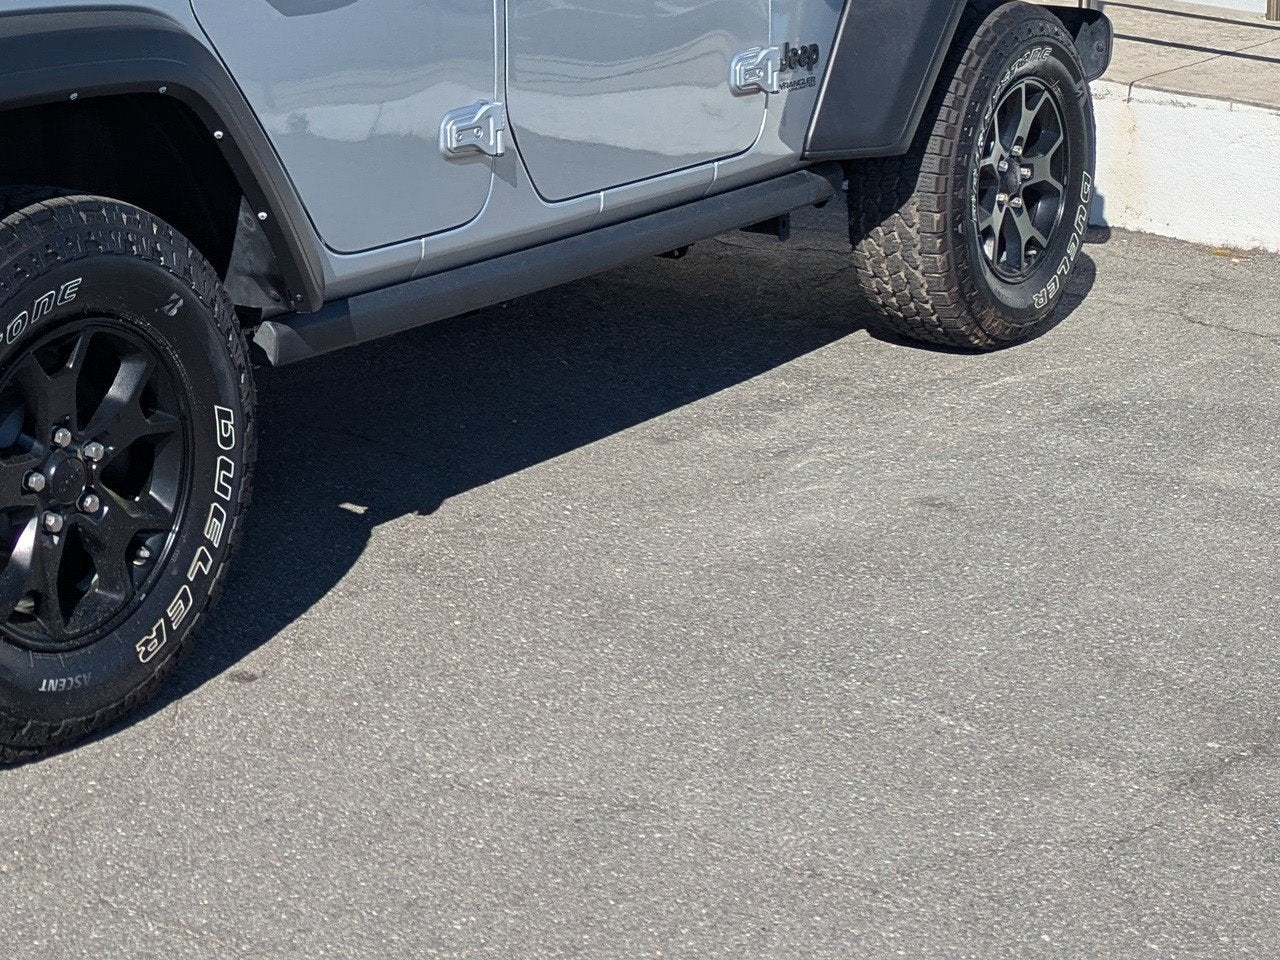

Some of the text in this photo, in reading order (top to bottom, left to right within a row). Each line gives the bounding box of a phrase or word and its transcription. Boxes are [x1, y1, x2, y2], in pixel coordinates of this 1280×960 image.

[779, 42, 819, 72] Jeep
[1032, 170, 1092, 309] DUELER
[135, 404, 235, 663] DUELER
[37, 671, 92, 692] ASCENT
